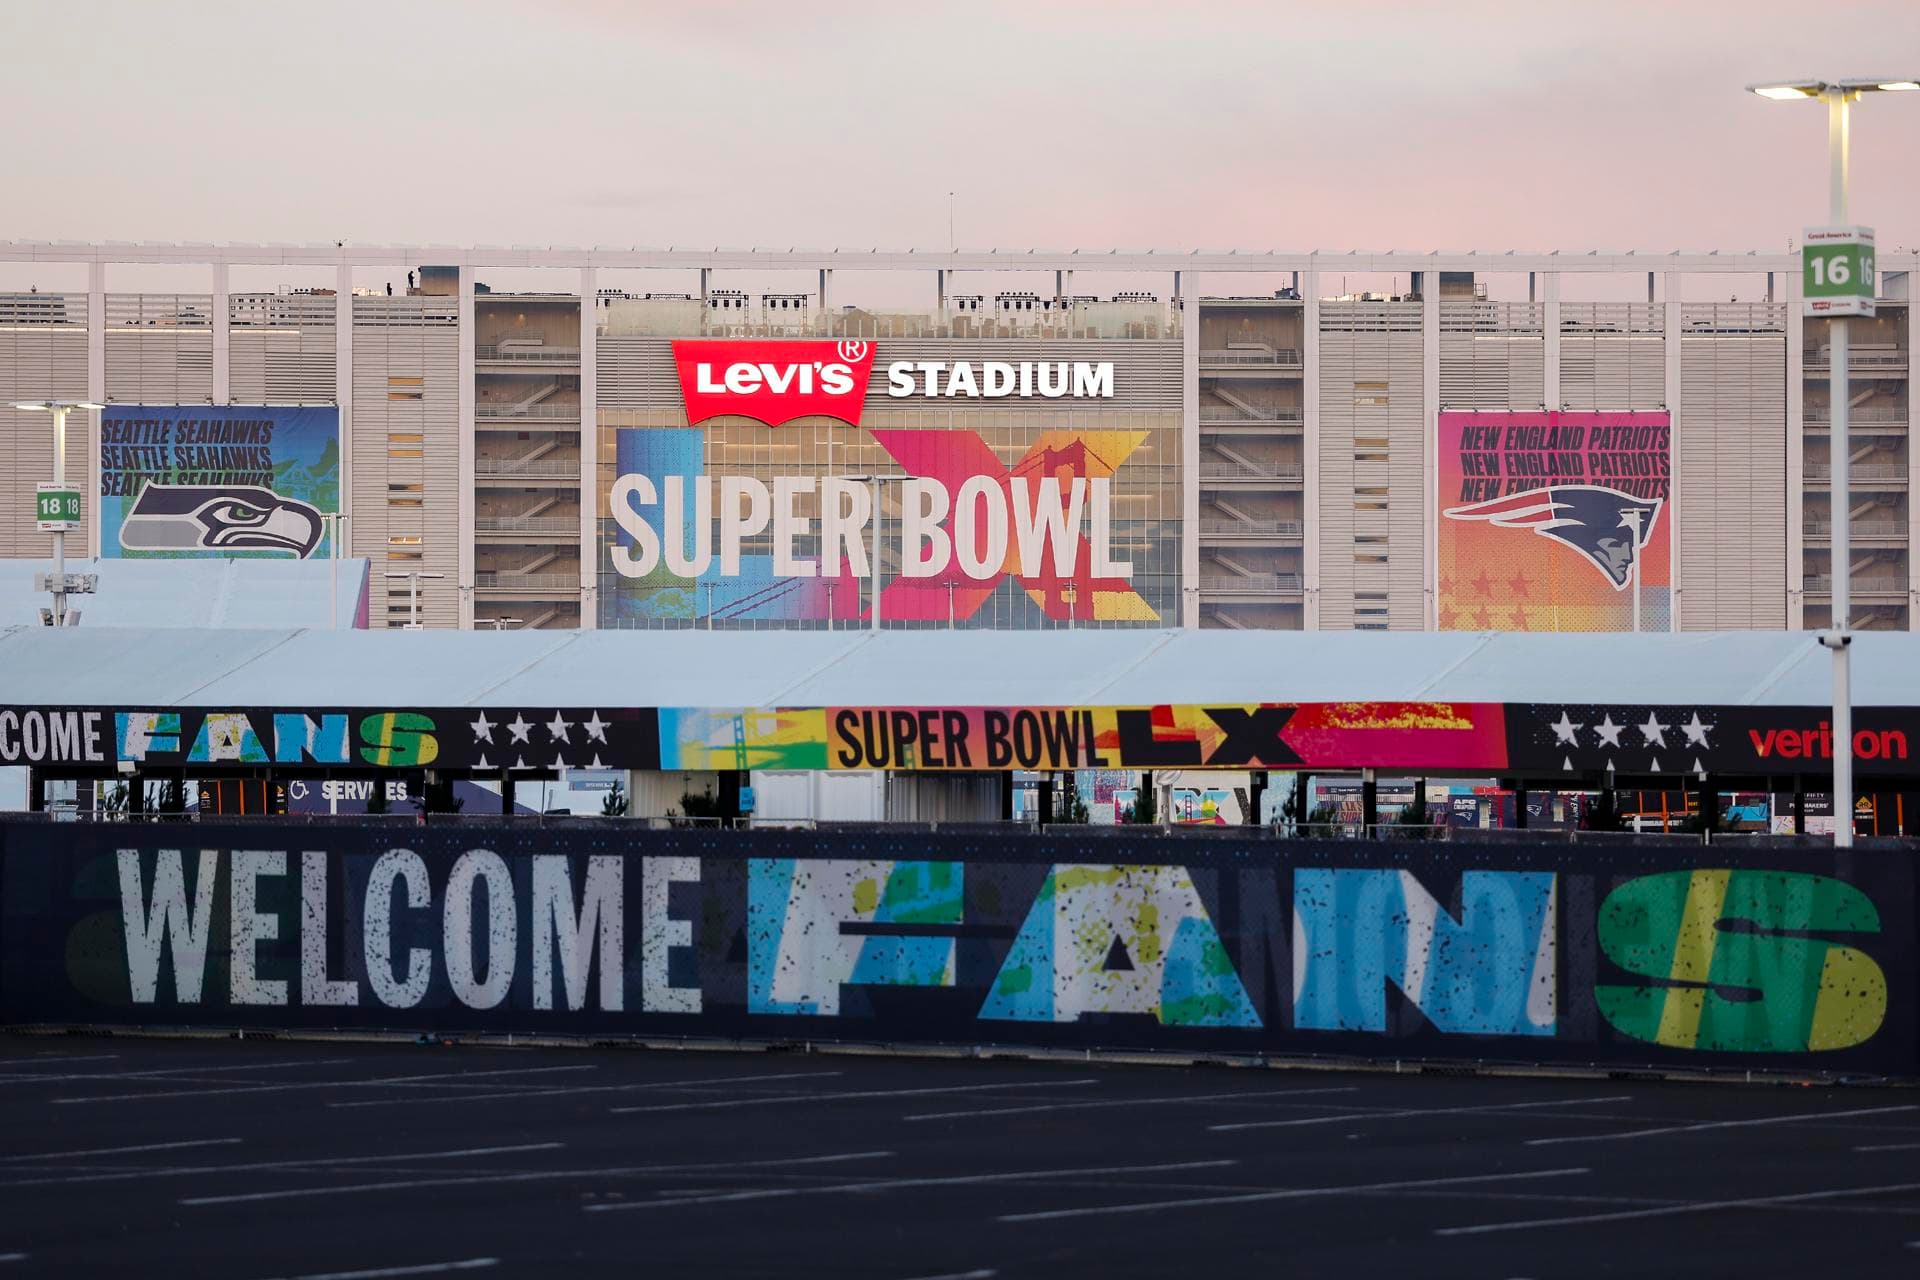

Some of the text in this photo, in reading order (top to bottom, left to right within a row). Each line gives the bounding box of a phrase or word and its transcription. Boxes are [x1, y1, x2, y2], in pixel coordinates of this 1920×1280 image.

[1810, 255, 1850, 286] 16
[1859, 256, 1873, 286] 16
[888, 361, 1115, 398] STADIUM
[101, 419, 274, 445] SEATTLE SEAHAWKS
[1460, 426, 1670, 450] NEW ENGLAND PATRIOTS
[101, 445, 273, 471] SEATTLE SEAHAWKS
[1460, 452, 1670, 476] NEW ENGLAND PATRIOTS
[1460, 478, 1502, 502] NEW
[41, 497, 61, 515] 18
[66, 497, 79, 515] 18
[610, 473, 1134, 580] SUPER BOWL
[114, 712, 439, 767] FANS
[835, 707, 1307, 768] SUPER BOWL LX
[1749, 720, 1908, 759] verion
[321, 780, 408, 801] SERVIES
[116, 848, 1888, 1053] WELCOME FANS
